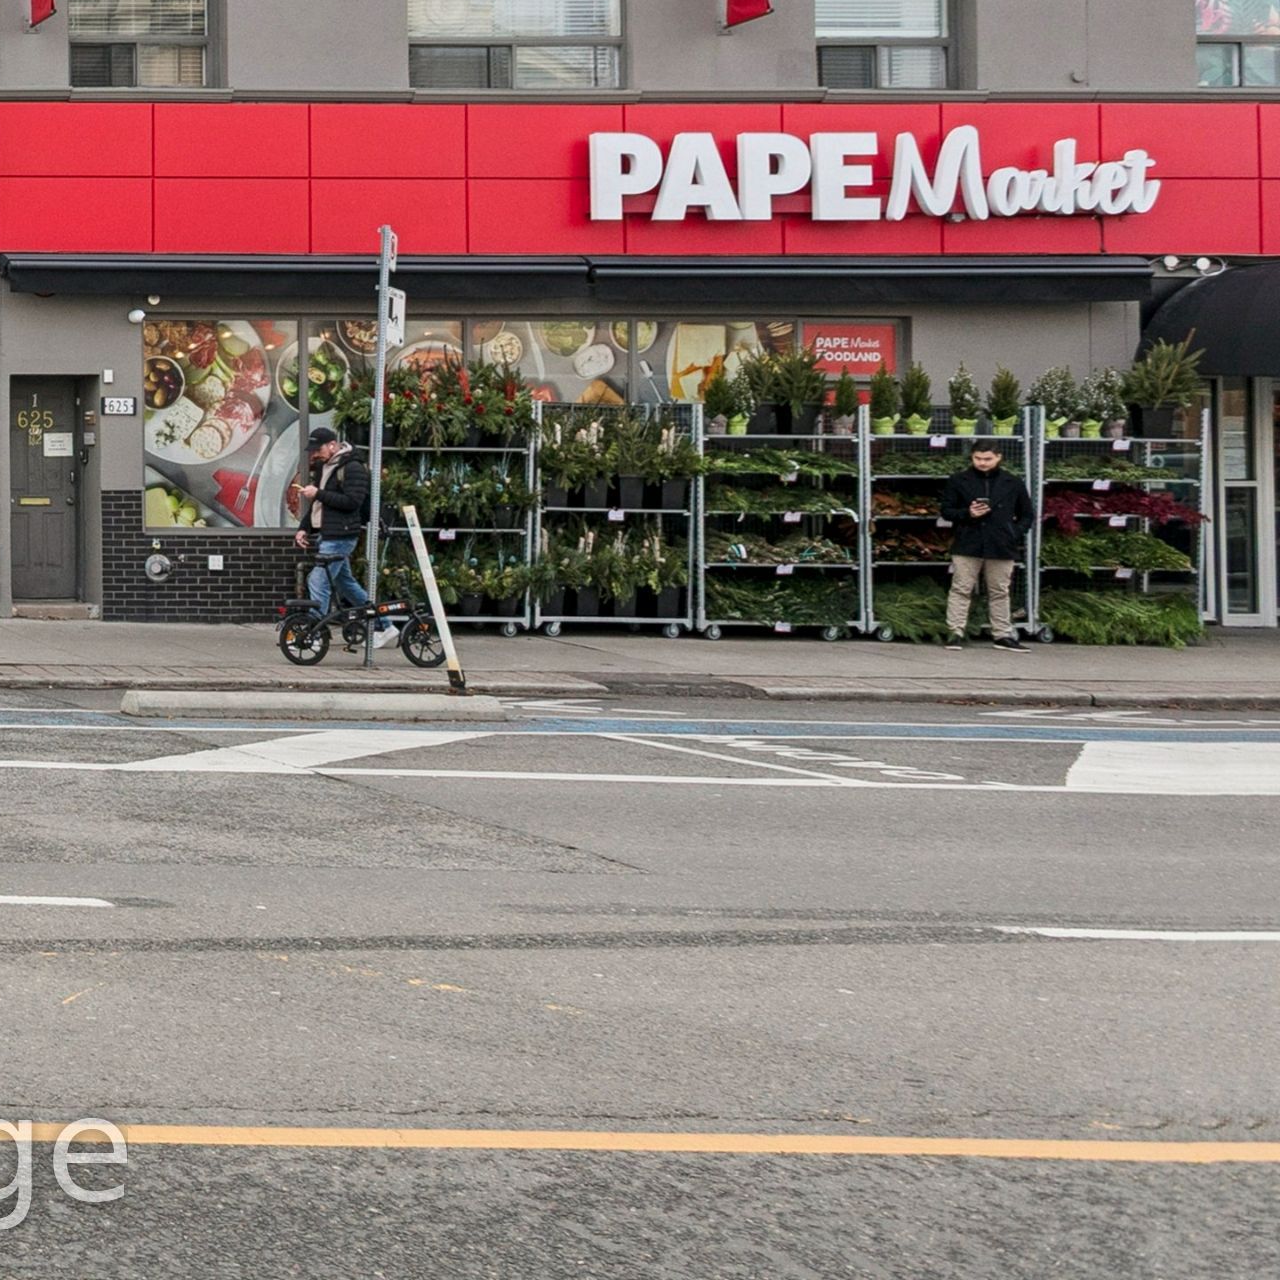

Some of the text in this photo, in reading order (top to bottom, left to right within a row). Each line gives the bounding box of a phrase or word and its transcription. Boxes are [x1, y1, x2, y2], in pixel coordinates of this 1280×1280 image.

[589, 124, 1161, 221] PAPE Market
[815, 336, 849, 349] PAPE
[815, 348, 882, 362] FOODLAND
[108, 400, 129, 413] 625
[17, 410, 54, 429] 625
